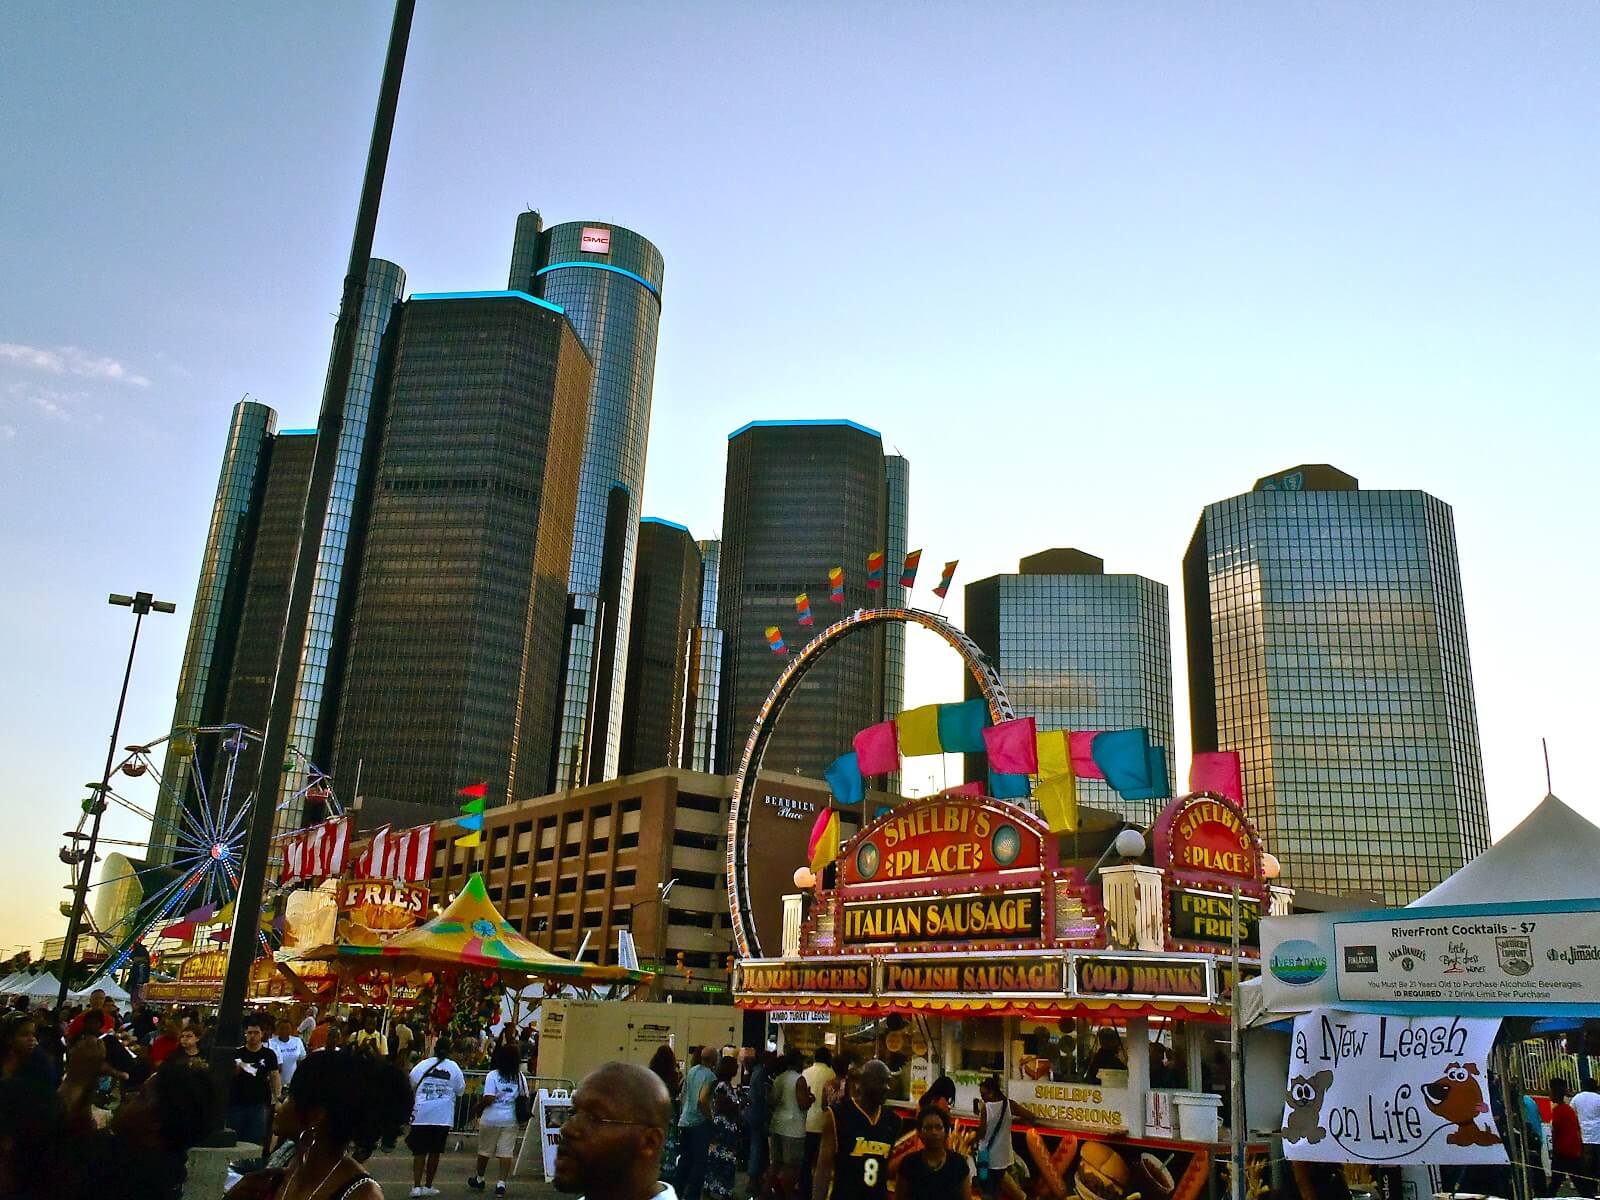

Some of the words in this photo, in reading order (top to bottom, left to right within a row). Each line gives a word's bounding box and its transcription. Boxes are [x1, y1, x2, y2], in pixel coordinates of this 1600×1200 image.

[583, 236, 609, 244] GMC
[765, 795, 816, 812] BEAUBIEN
[777, 806, 803, 820] Place
[884, 807, 991, 847] SHELBI'S
[1180, 803, 1251, 850] SHELBI'S
[896, 843, 973, 877] PLACE
[1192, 847, 1243, 873] PLACE
[345, 884, 422, 912] FRIES
[845, 907, 921, 937] ITALIAN
[927, 898, 1032, 934] SAUSAGE
[1391, 926, 1449, 938] RiverFront
[1452, 923, 1508, 935] Cocktails
[1520, 922, 1536, 934] $7
[743, 967, 869, 991] HAMBURGERS
[888, 966, 959, 990] POLISH
[963, 963, 1060, 990] SAUSAGE
[1082, 962, 1130, 991] COLD
[1132, 966, 1202, 993] DRINKS
[1368, 981, 1380, 989] You
[1439, 980, 1451, 988] Old
[1500, 980, 1537, 988] Alcoholic
[1394, 990, 1402, 998] ID
[1403, 990, 1442, 998] REQUIRED
[1455, 990, 1475, 998] Drink
[1476, 990, 1495, 998] Limit
[1513, 990, 1551, 998] Purchase
[1295, 1030, 1309, 1064] a
[1319, 1015, 1368, 1068] New
[1379, 1016, 1468, 1062] Leash
[1035, 1085, 1103, 1104] SHELBI'S
[1329, 1106, 1361, 1142] on
[1369, 1084, 1422, 1144] Life
[864, 1158, 879, 1188] 8
